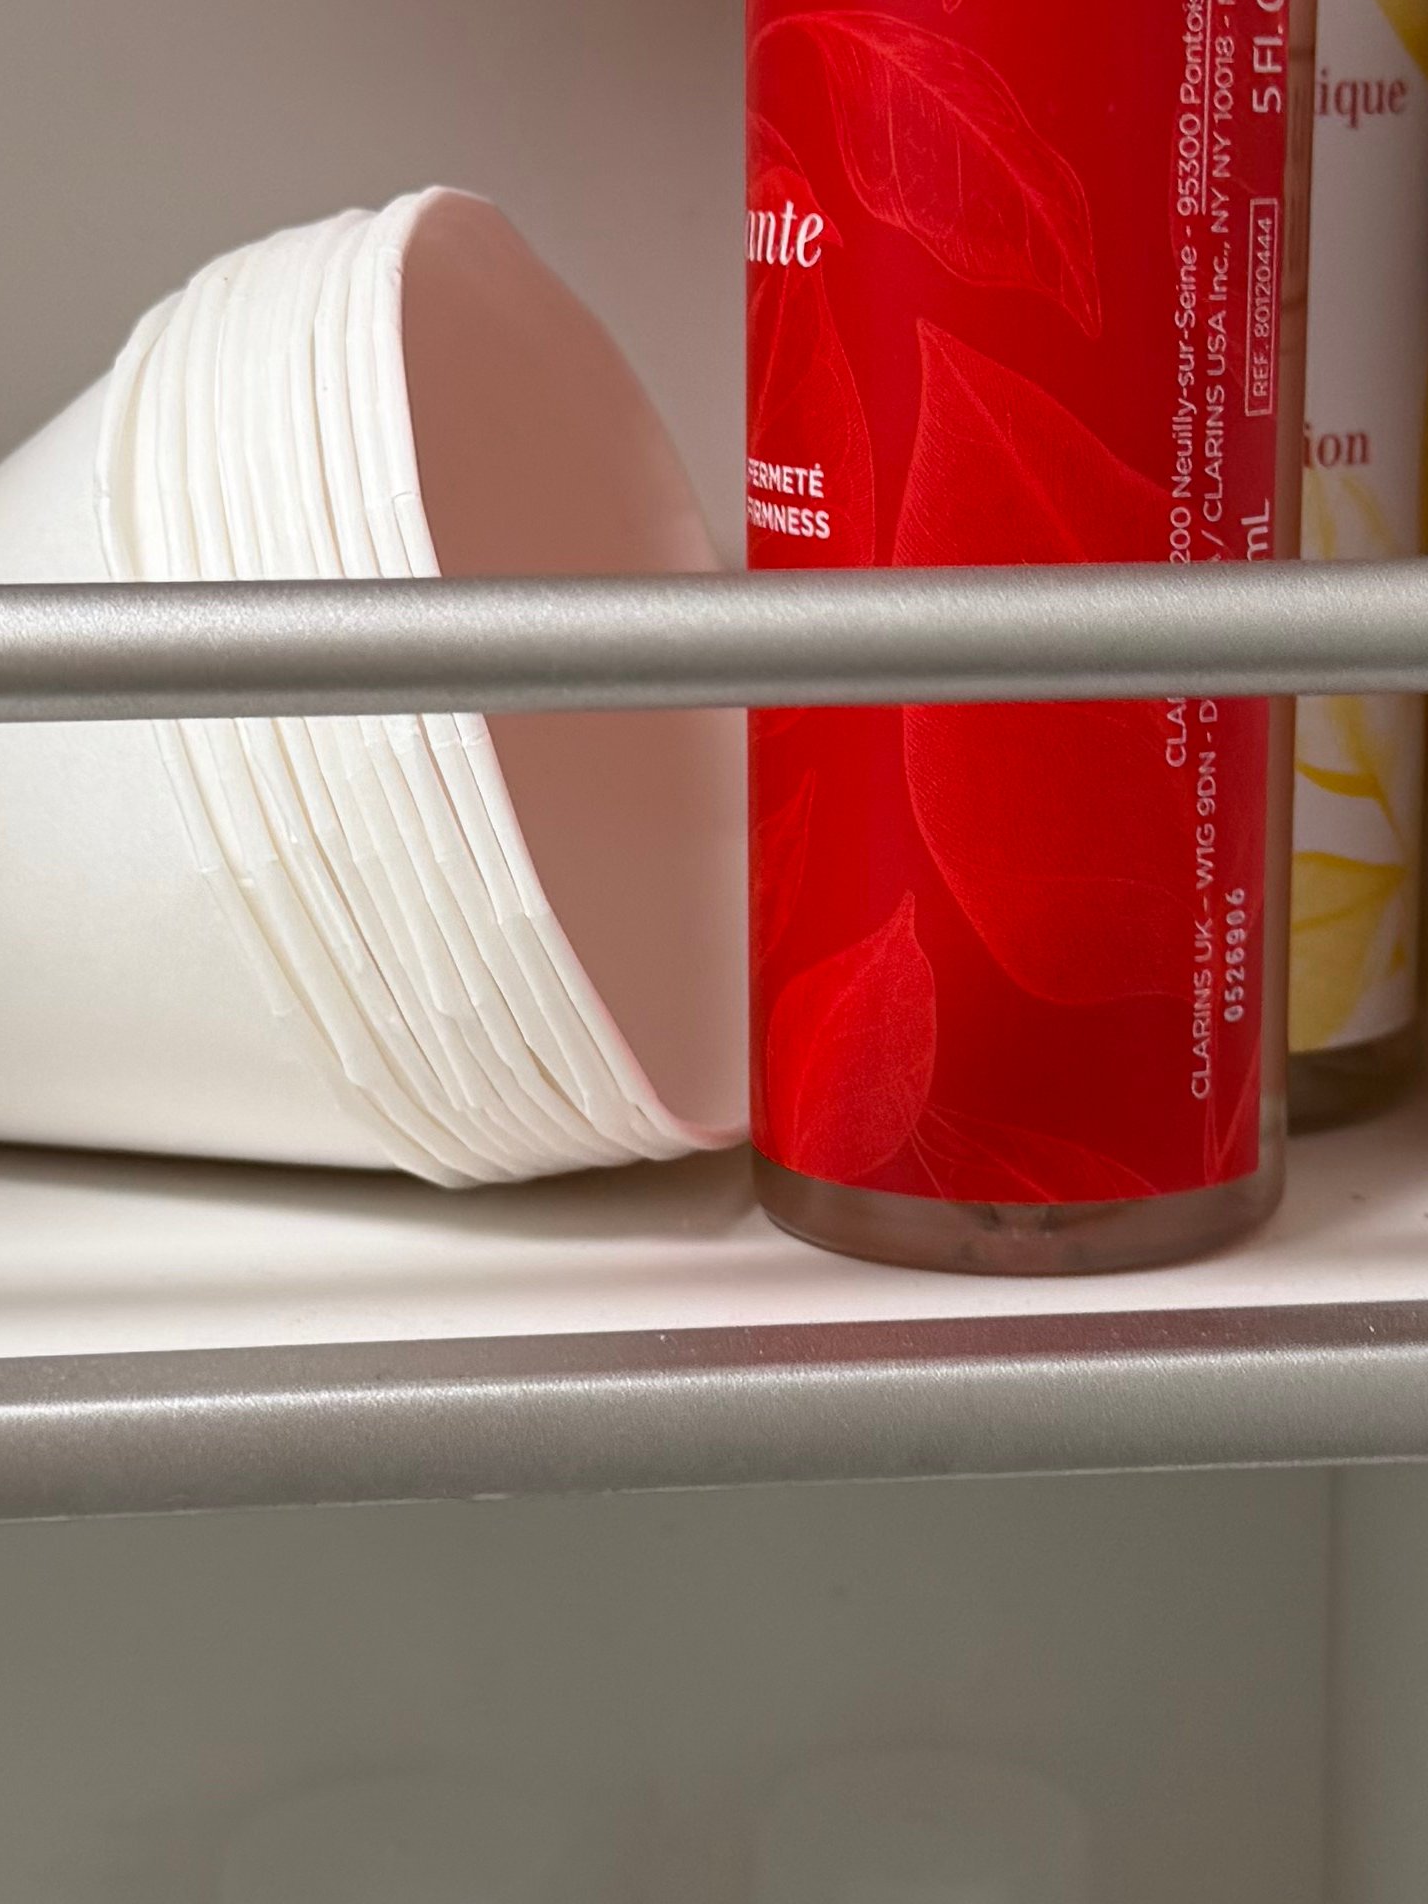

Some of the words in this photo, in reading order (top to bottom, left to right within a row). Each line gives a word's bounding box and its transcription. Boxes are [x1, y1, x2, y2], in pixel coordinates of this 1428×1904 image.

[1213, 36, 1235, 124] 10018
[1252, 85, 1282, 114] 5
[1176, 113, 1201, 216] 95300
[1212, 130, 1232, 178] NY
[1211, 186, 1230, 234] NY
[1253, 217, 1273, 338] 80120444
[1171, 244, 1199, 498] Neuilly-sur-Seine
[1207, 310, 1227, 377] USA
[1202, 384, 1225, 522] CLARINS
[1196, 751, 1217, 816] 9DN
[1195, 823, 1216, 890] W1G
[1194, 918, 1213, 963] UK
[1223, 887, 1247, 1023] 0526906
[1191, 969, 1213, 1100] CLARINS
